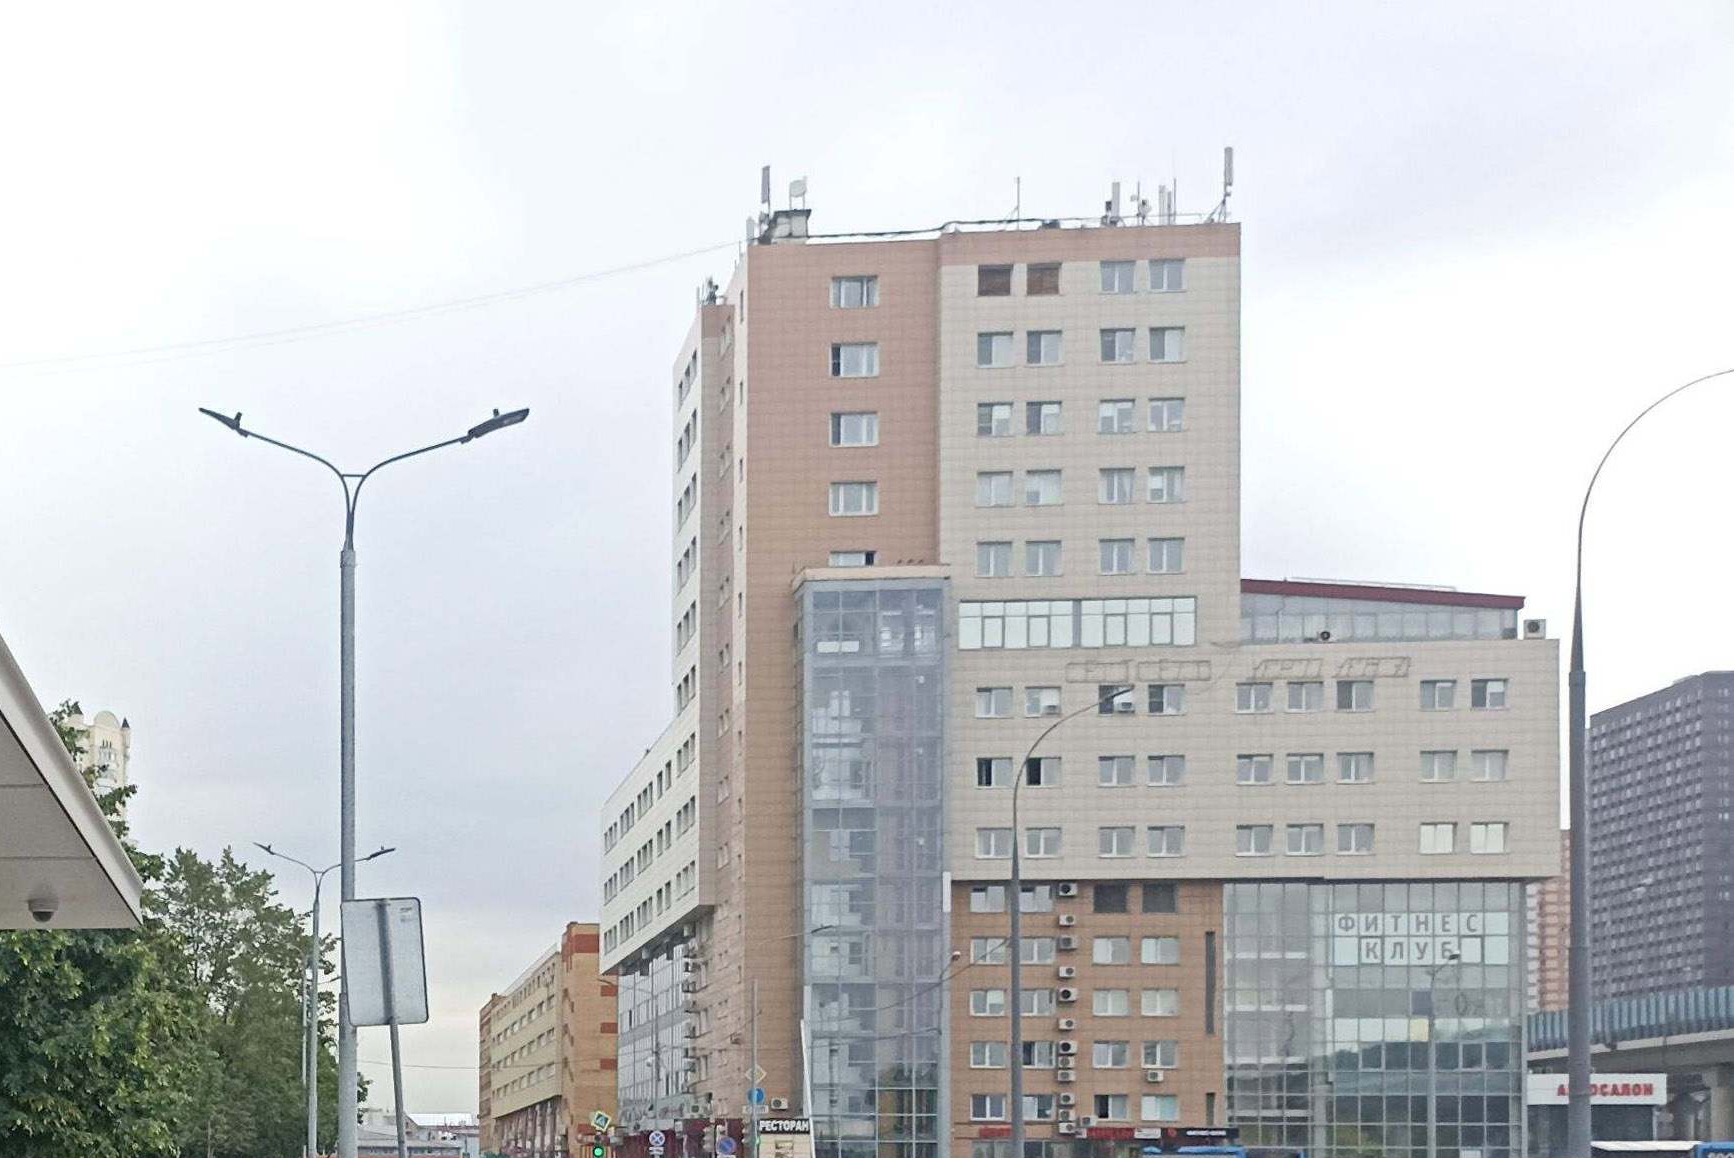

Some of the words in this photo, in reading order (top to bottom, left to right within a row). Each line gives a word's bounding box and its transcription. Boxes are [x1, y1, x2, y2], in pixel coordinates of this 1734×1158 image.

[1338, 915, 1478, 932] ФИТНЕС
[1366, 941, 1456, 960] КЛУБ
[1557, 1083, 1654, 1097] АОСАЛОН
[759, 1119, 810, 1132] РЕСТОРАН
